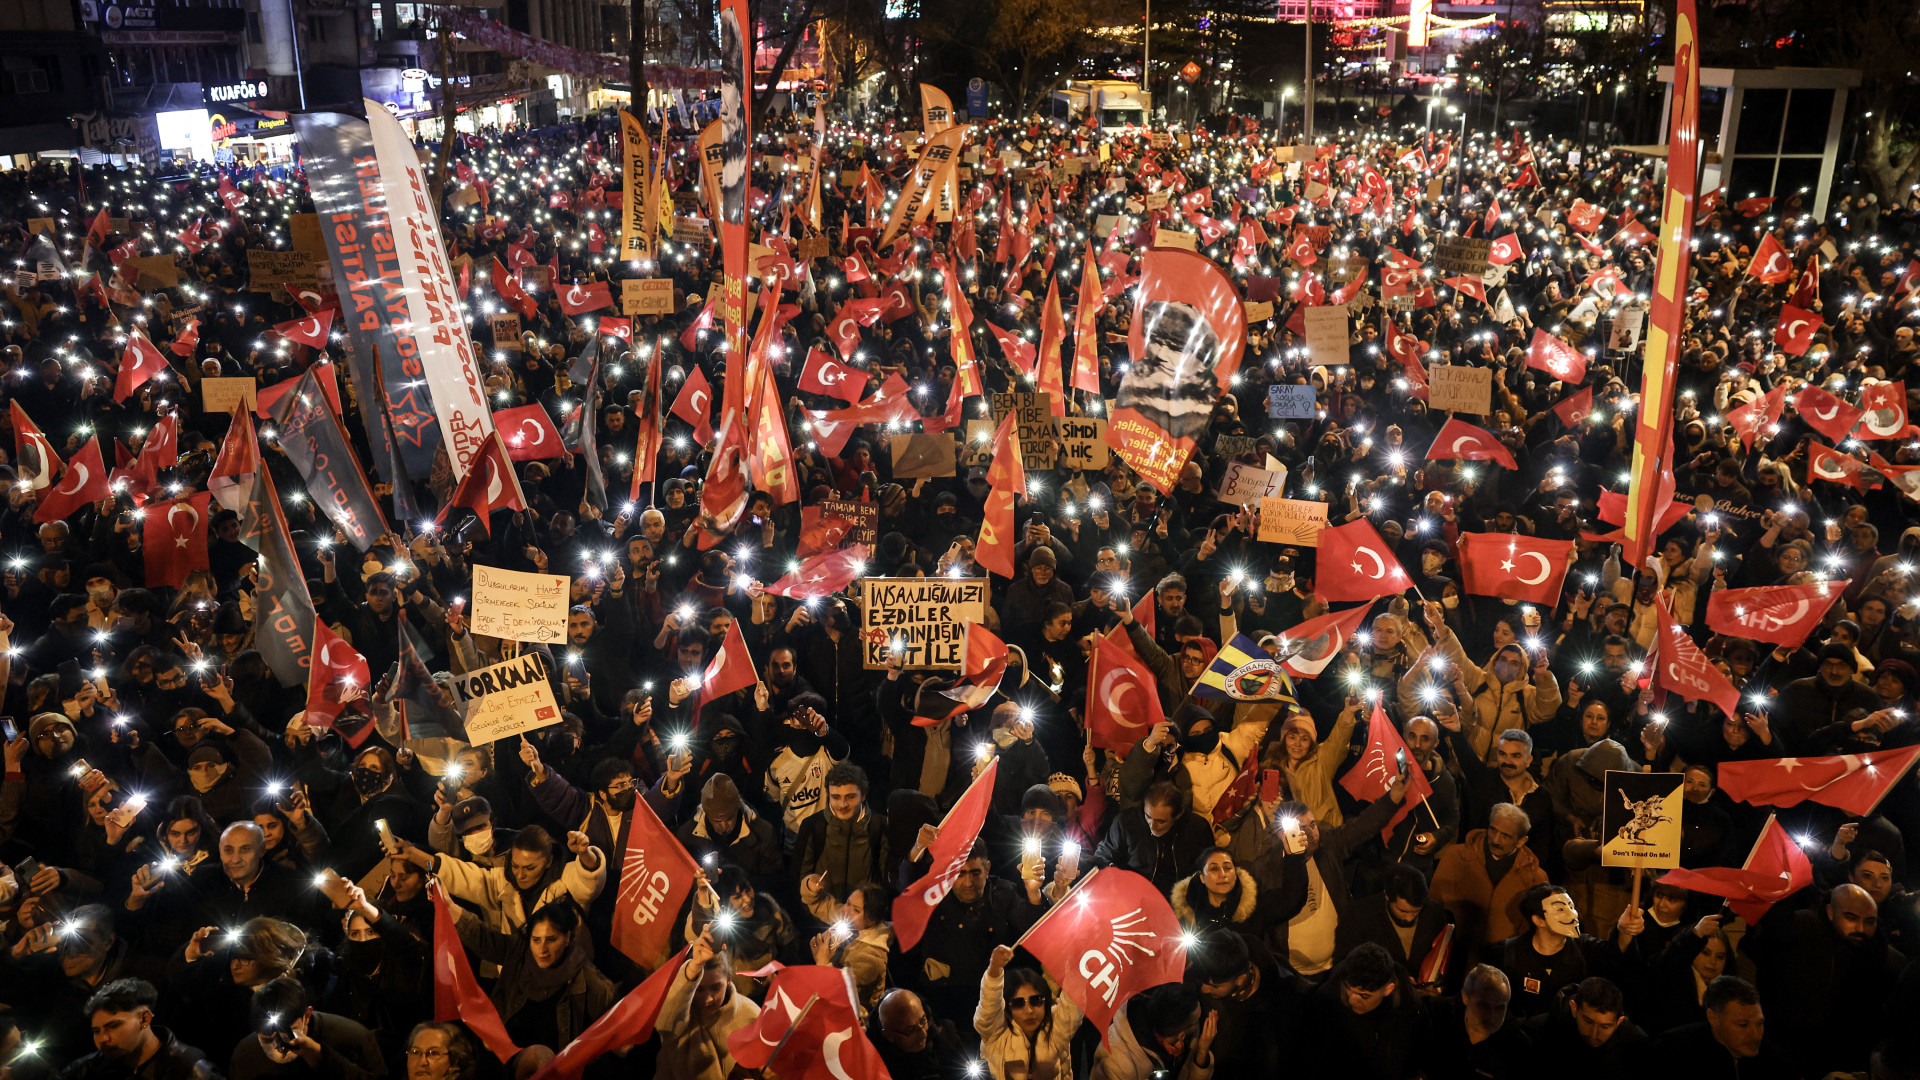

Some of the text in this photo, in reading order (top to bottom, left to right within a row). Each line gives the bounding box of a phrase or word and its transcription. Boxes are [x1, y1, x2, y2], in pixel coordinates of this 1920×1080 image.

[125, 7, 154, 18] AGT
[211, 81, 256, 101] KUAFÖR
[258, 119, 285, 130] Penguen
[1271, 386, 1295, 394] SARAY
[993, 394, 1018, 409] BEN
[1277, 408, 1300, 417] GEL
[1062, 421, 1097, 441] ŞİMDİ
[1071, 441, 1093, 462] HİÇ
[823, 501, 876, 515] TAMAM BEN
[1716, 499, 1761, 520] Bahçe
[871, 583, 983, 608] İNSANLIĞIMIZI
[869, 605, 952, 626] EZDİLER
[455, 652, 545, 702] KORKMA!
[1227, 662, 1275, 689] FENERBAHÇE
[1669, 662, 1711, 693] CHP
[1612, 849, 1630, 857] Don't
[632, 870, 670, 926] CHP
[1079, 949, 1120, 1009] CH
